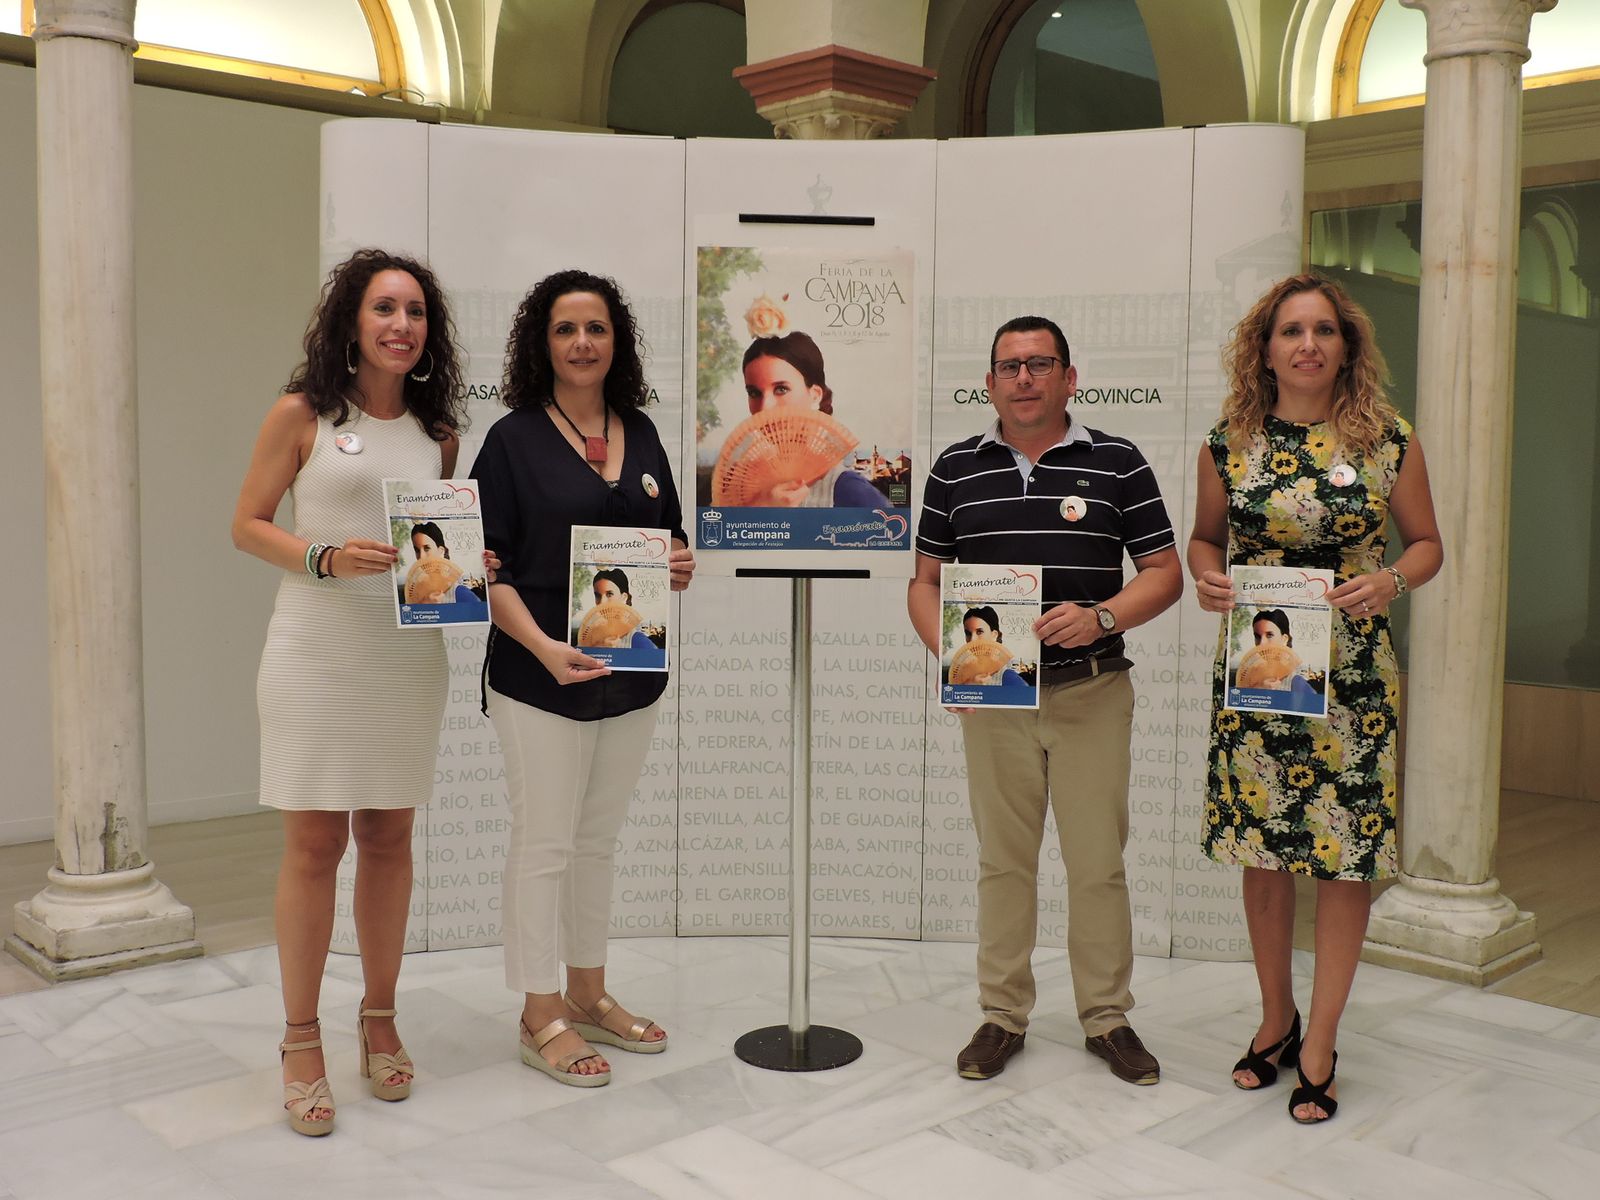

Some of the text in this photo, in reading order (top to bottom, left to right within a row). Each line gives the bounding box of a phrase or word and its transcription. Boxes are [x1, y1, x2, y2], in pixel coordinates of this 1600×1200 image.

[859, 267, 873, 277] DE
[880, 267, 894, 277] LA
[804, 276, 907, 305] CAMPANA
[824, 302, 886, 329] 2018
[396, 489, 455, 504] Enamórate!
[726, 521, 791, 531] ayuntamiento de
[726, 529, 791, 542] La Campana
[582, 539, 647, 551] Enamórate!
[953, 576, 1016, 589] Enamórate!
[1242, 579, 1307, 591] Enamórate!
[876, 632, 897, 647] DE
[1158, 642, 1187, 658] LAS
[682, 654, 753, 672] CAÑADA
[824, 658, 842, 672] LA
[1152, 669, 1197, 686] LORA
[715, 683, 744, 698] DEL
[750, 680, 778, 698] RÍO
[706, 710, 766, 726] PRUNA,
[461, 742, 482, 757] DE
[698, 735, 773, 751] PEDRERA,
[849, 736, 869, 750] DE
[876, 737, 895, 752] LA
[901, 737, 945, 756] JARA,
[664, 763, 674, 777] Y
[864, 762, 892, 777] LAS
[440, 792, 473, 811] RÍO,
[480, 793, 497, 807] EL
[651, 786, 728, 802] MAIRENA
[734, 786, 763, 800] DEL
[836, 787, 852, 801] EL
[858, 787, 965, 808] RONQUILLO,
[684, 811, 748, 828] SEVILLA,
[820, 812, 841, 826] DE
[847, 811, 937, 833] GUADAÍRA,
[466, 847, 486, 861] LA
[634, 834, 749, 855] AZNALCÁZAR,
[755, 837, 774, 850] LA
[857, 838, 970, 859] SANTIPONCE,
[411, 895, 480, 918] UZMÁN,
[622, 888, 688, 904] CAMPO,
[695, 888, 713, 902] EL
[812, 888, 875, 905] GELVES,
[882, 888, 953, 911] HUÉVAR,
[1163, 908, 1242, 926] MAIRENA
[692, 913, 722, 928] DEL
[811, 914, 896, 932] TOMARES,
[1140, 932, 1160, 947] LA
